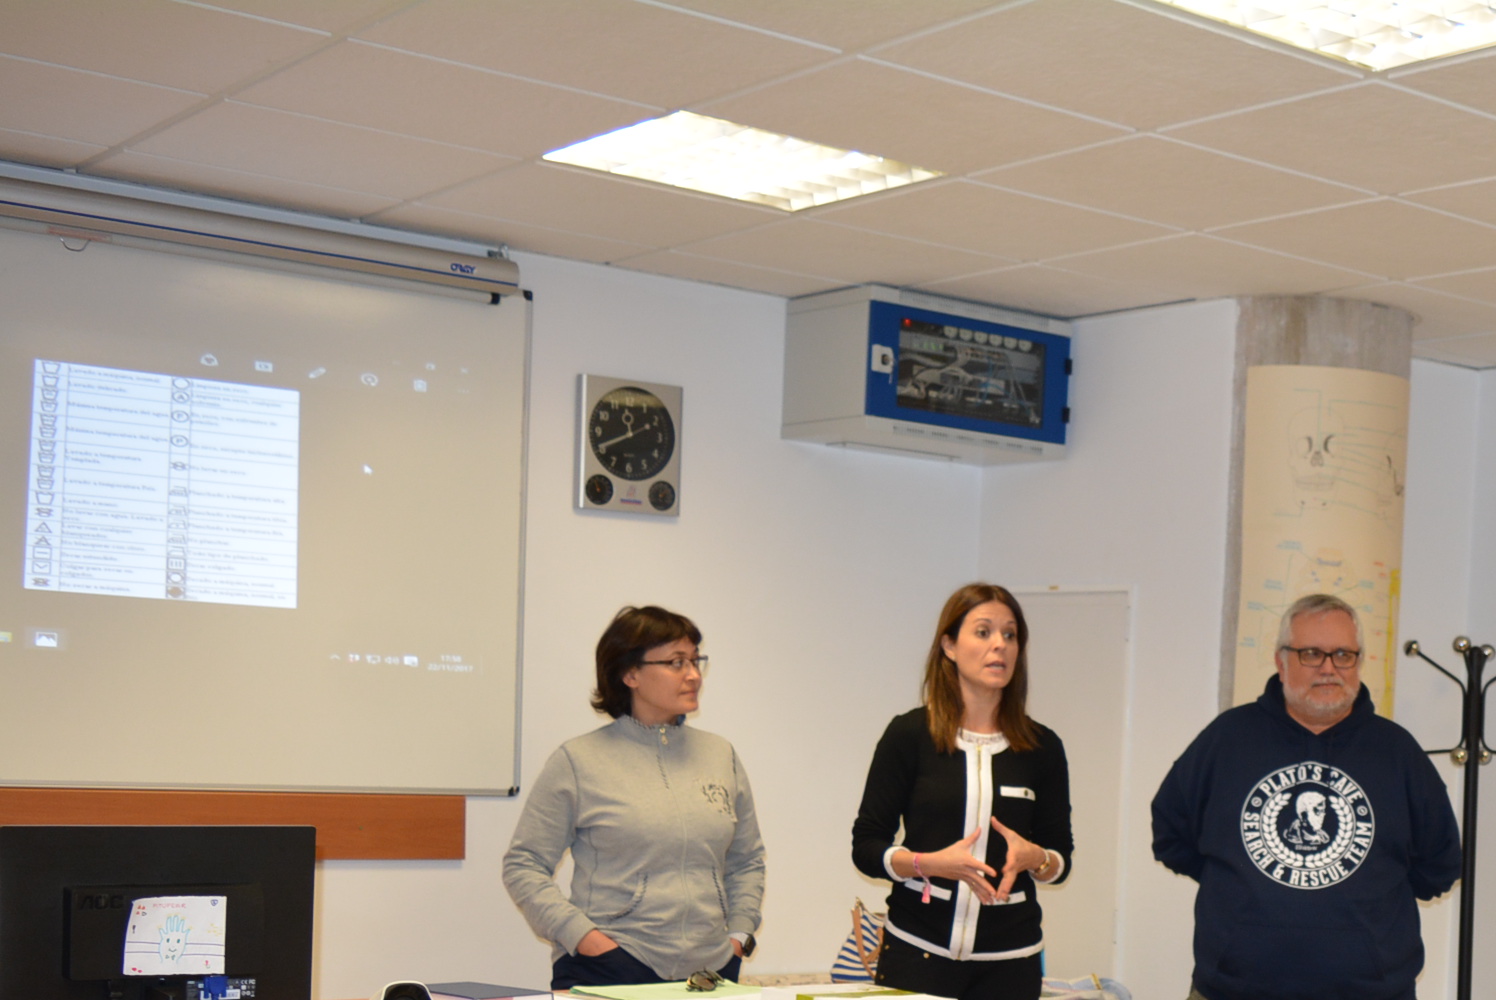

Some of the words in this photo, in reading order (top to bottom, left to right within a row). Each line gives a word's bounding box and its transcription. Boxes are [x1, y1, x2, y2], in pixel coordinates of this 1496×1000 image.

[1259, 765, 1323, 798] PLATO'S
[1242, 811, 1273, 870] SEARCH
[1272, 865, 1286, 880] &
[1289, 862, 1350, 887] RESCUE
[1345, 822, 1373, 865] TEAM
[80, 895, 124, 910] AOC
